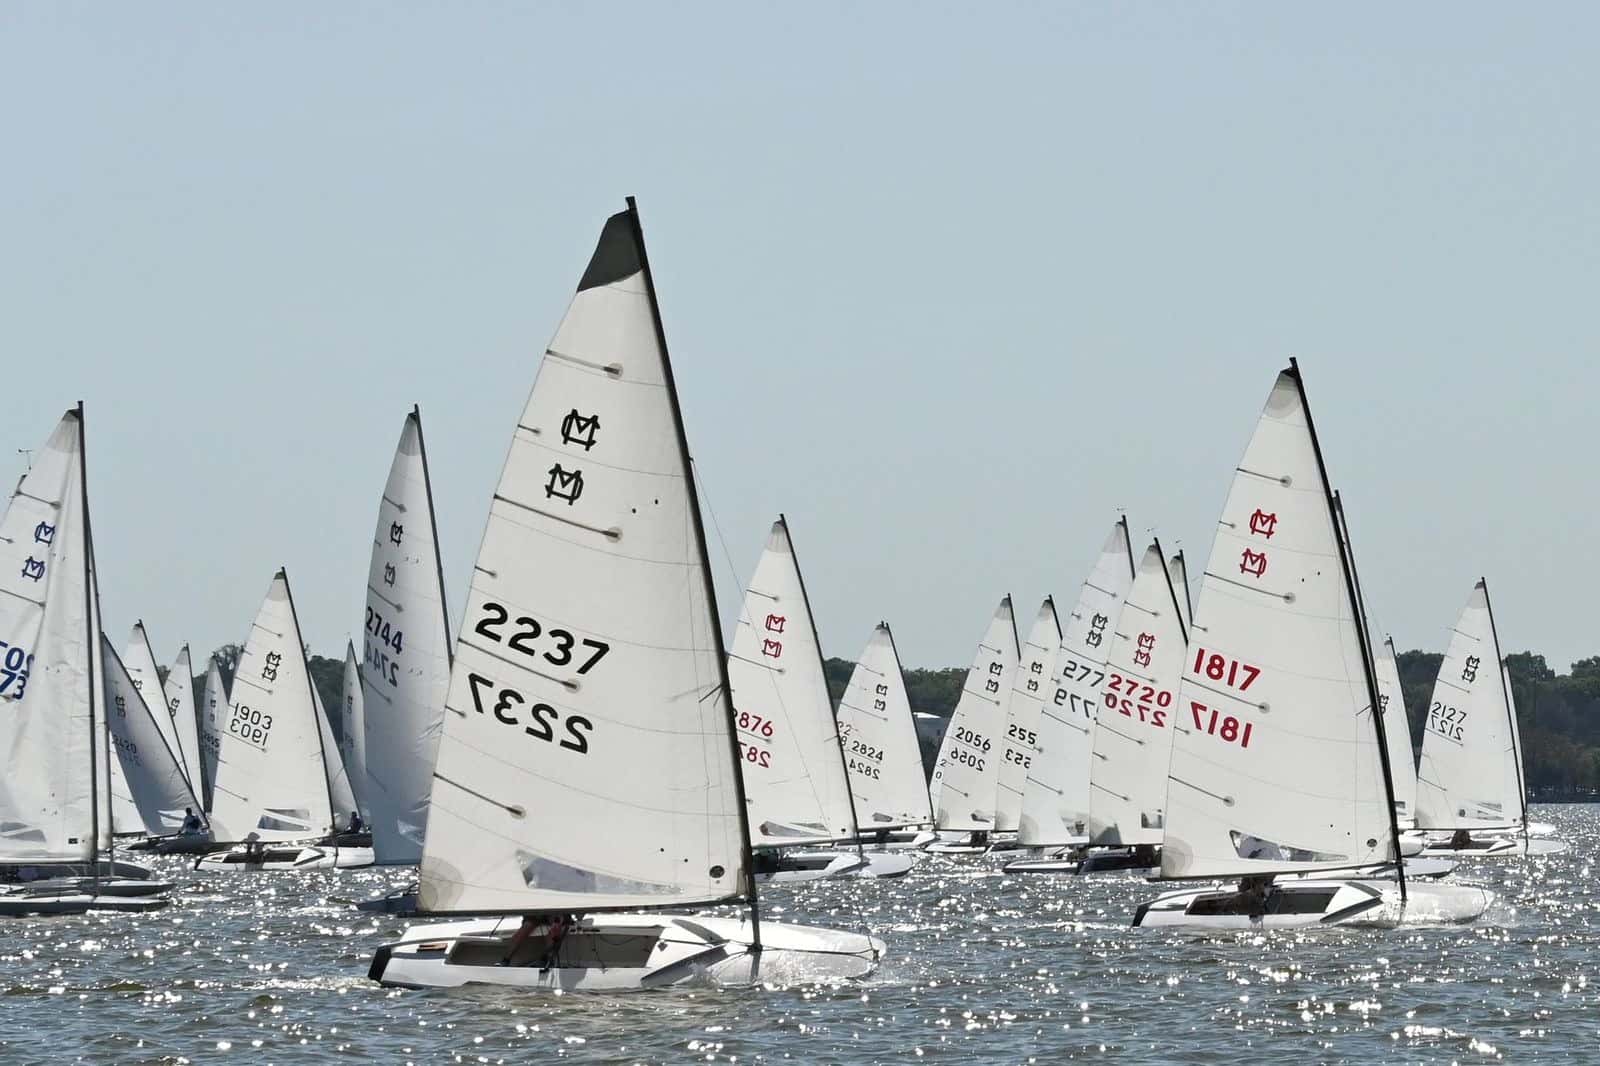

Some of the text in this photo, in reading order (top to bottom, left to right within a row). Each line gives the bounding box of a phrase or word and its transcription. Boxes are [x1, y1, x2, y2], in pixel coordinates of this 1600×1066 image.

[365, 606, 403, 655] 2744
[475, 602, 610, 674] 2237
[1062, 660, 1105, 687] 277
[1193, 648, 1261, 691] 1817
[1108, 673, 1172, 707] 2720
[234, 702, 273, 730] 1903
[1432, 701, 1467, 724] 2127
[955, 726, 991, 751] 2056
[1008, 724, 1037, 745] 255
[852, 740, 884, 761] 2824
